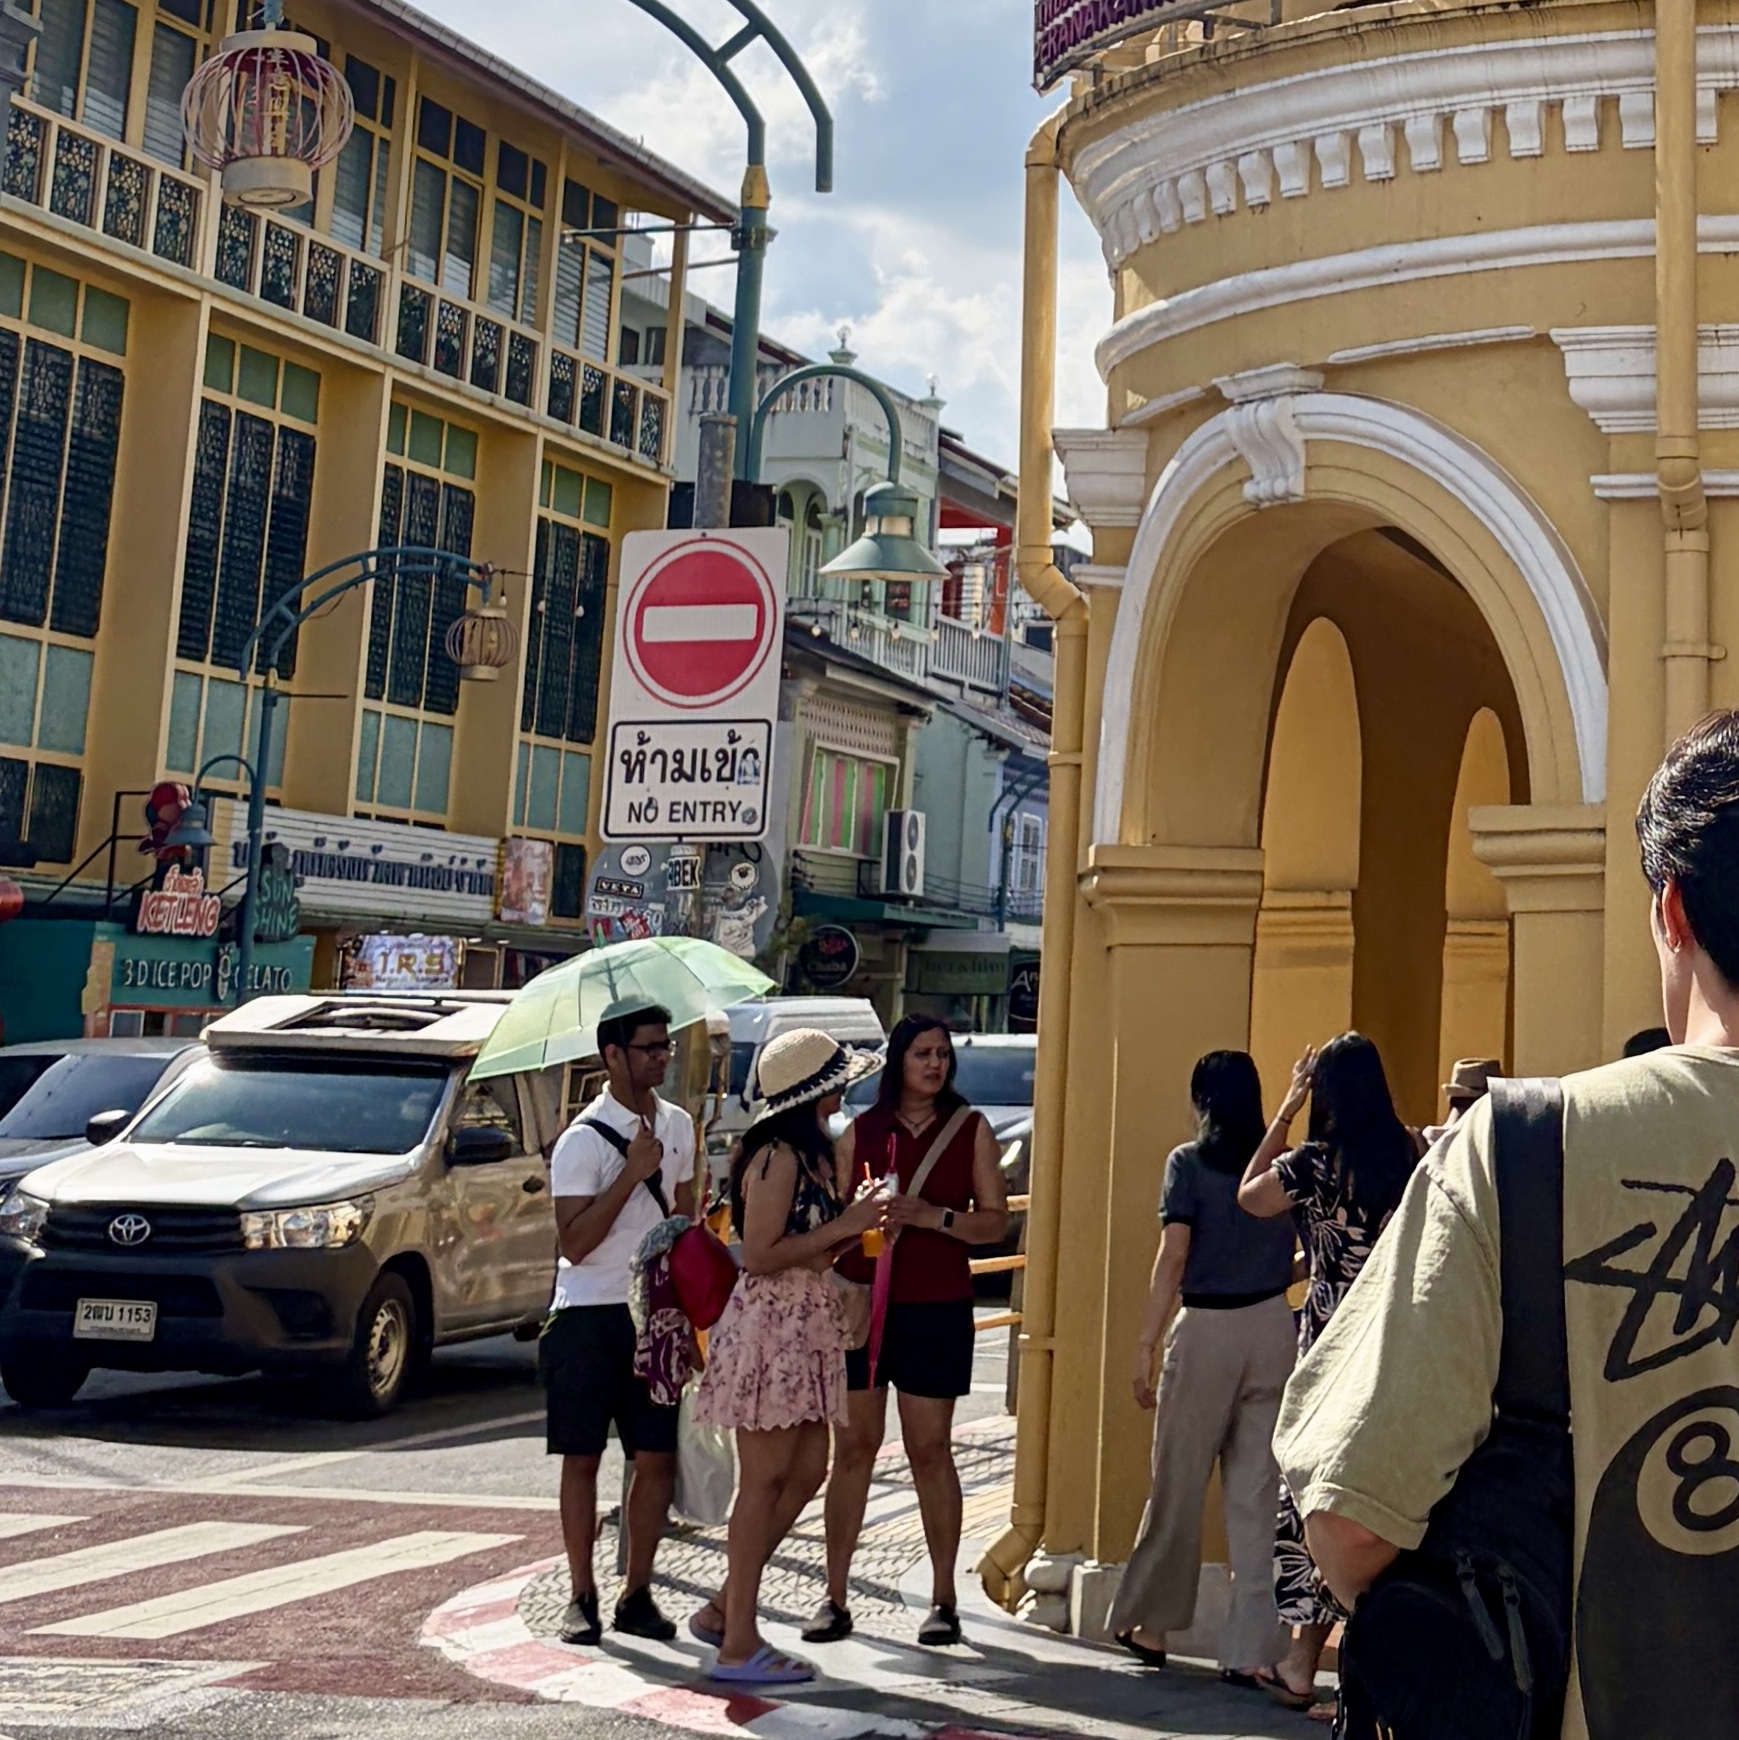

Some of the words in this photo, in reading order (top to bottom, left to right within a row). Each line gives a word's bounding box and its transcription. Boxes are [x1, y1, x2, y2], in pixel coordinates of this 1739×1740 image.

[628, 797, 658, 823] NO
[668, 800, 742, 823] ENTRY
[152, 961, 177, 987] ICE
[180, 962, 212, 988] POP
[119, 1306, 151, 1323] 1153
